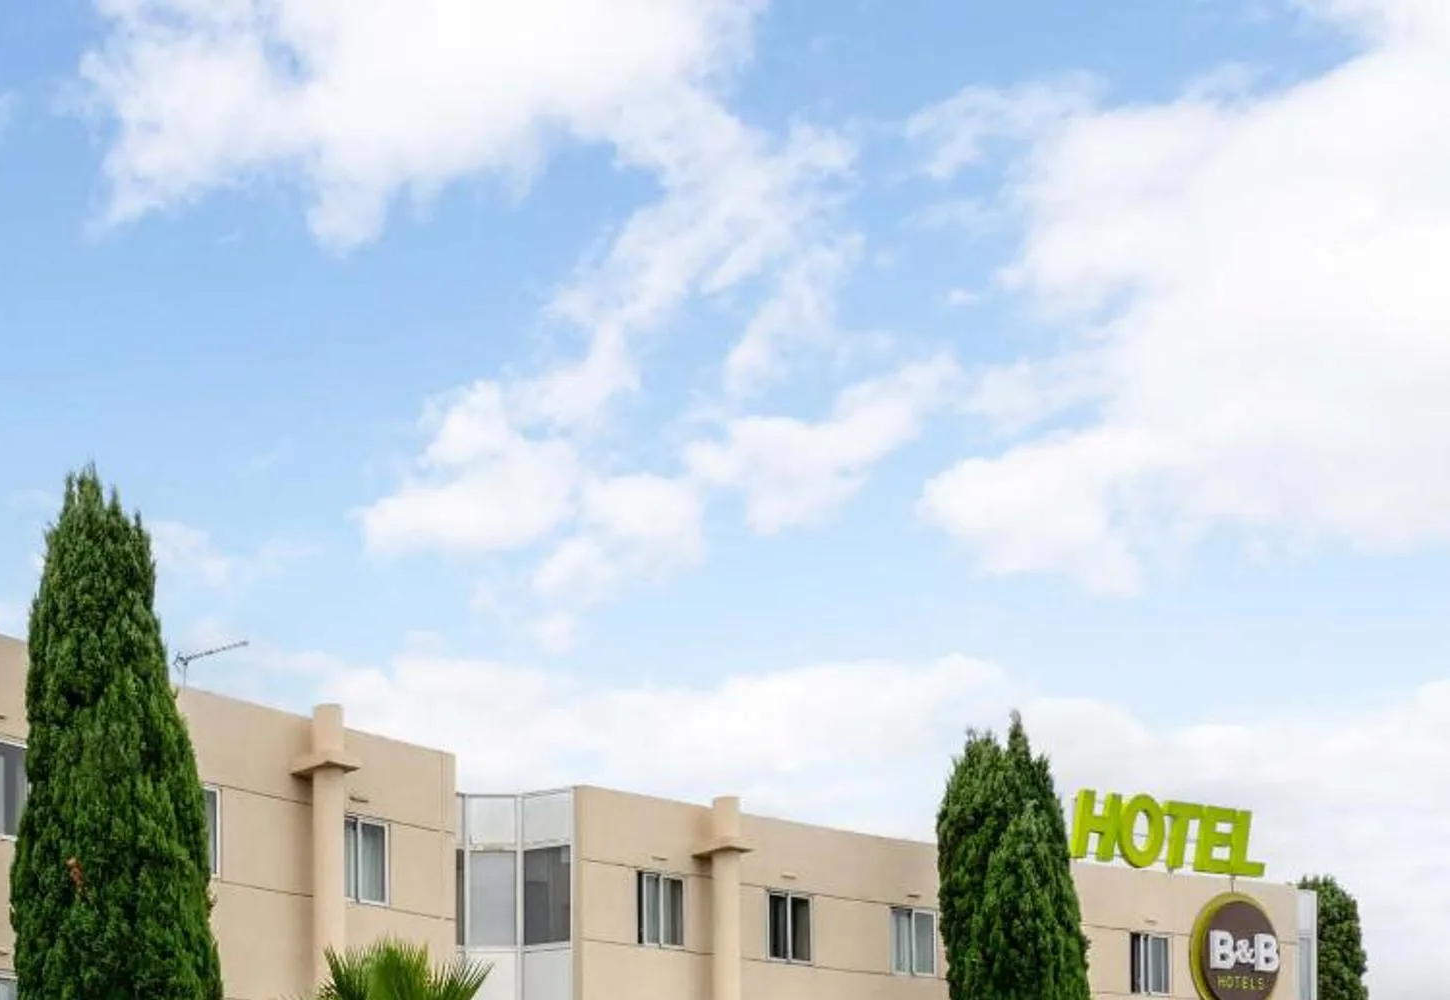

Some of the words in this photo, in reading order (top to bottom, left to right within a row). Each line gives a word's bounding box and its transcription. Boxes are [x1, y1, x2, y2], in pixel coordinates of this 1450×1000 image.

[1070, 789, 1266, 877] HOTEL
[1209, 929, 1279, 972] B&B
[1217, 975, 1265, 991] HOTELS
